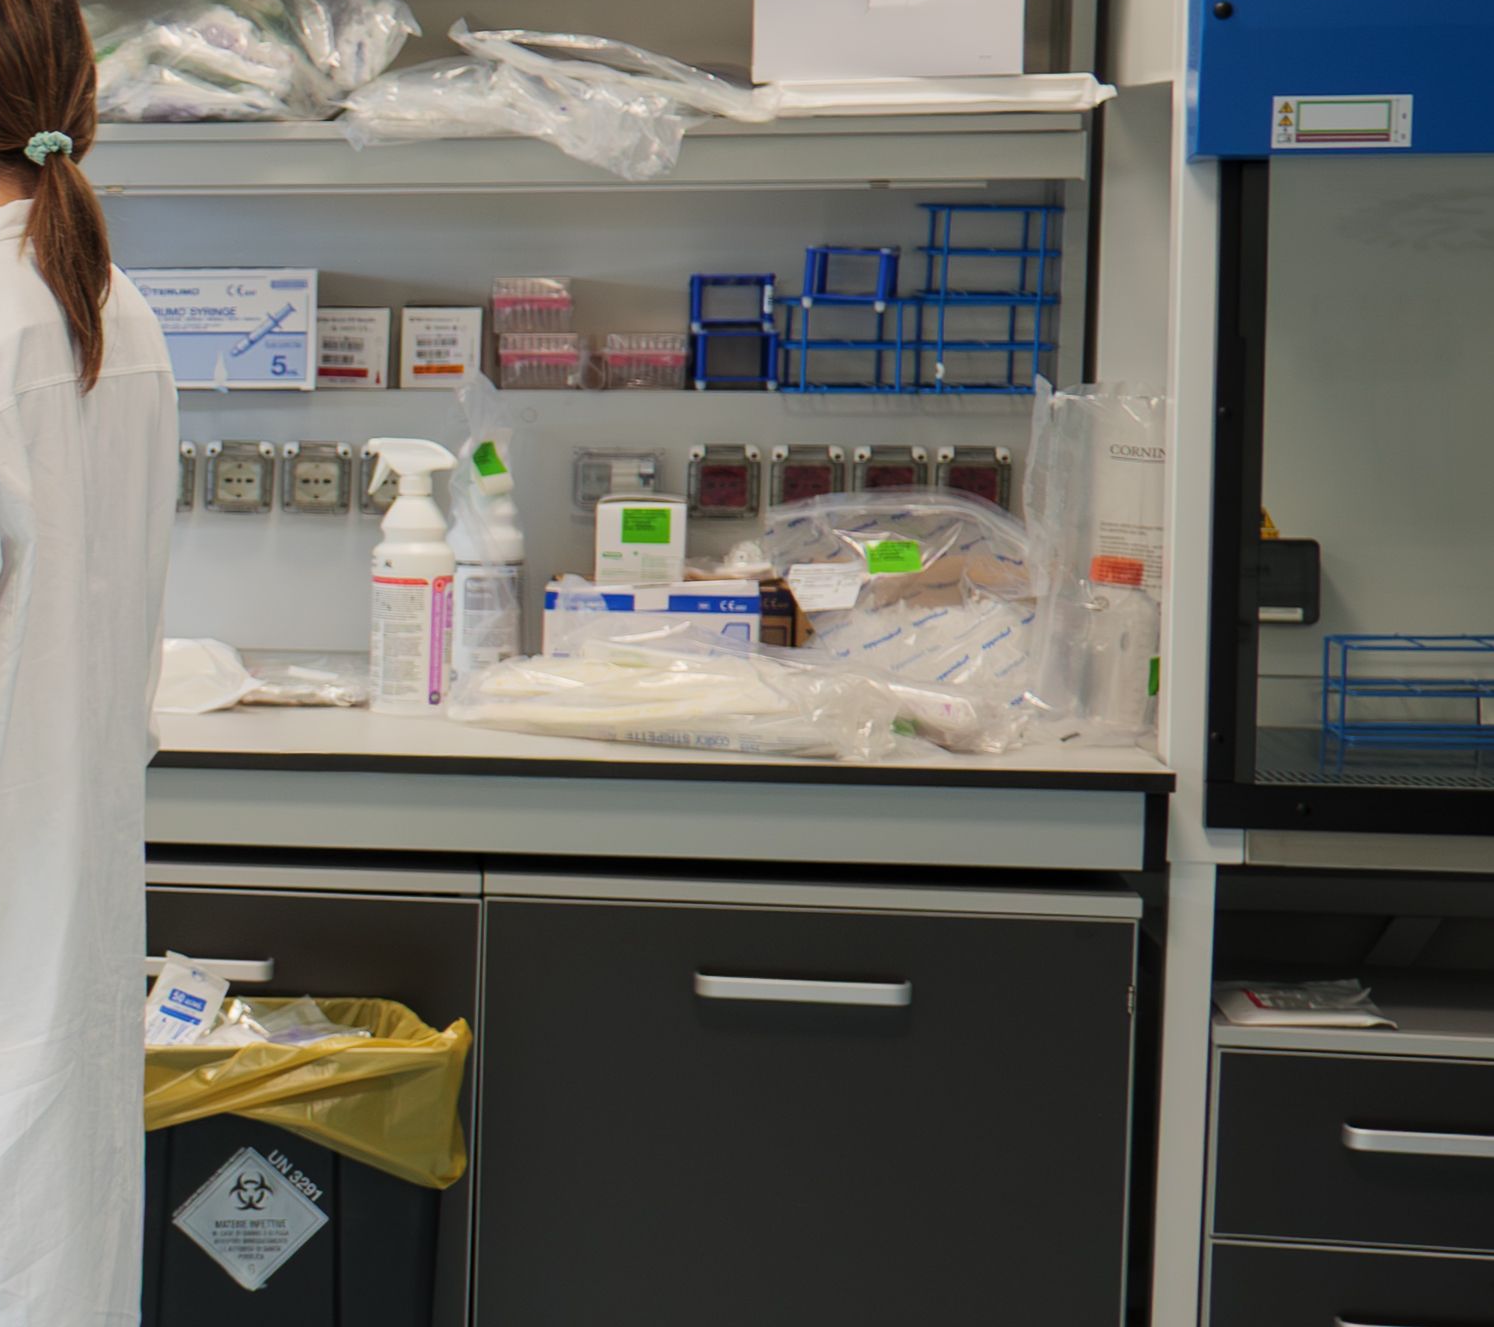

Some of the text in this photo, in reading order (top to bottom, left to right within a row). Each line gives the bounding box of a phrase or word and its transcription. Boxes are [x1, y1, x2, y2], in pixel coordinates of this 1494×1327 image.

[152, 306, 237, 316] RUMO SYRINGE
[1109, 444, 1167, 459] CORNIN
[268, 1149, 324, 1202] UN 3291
